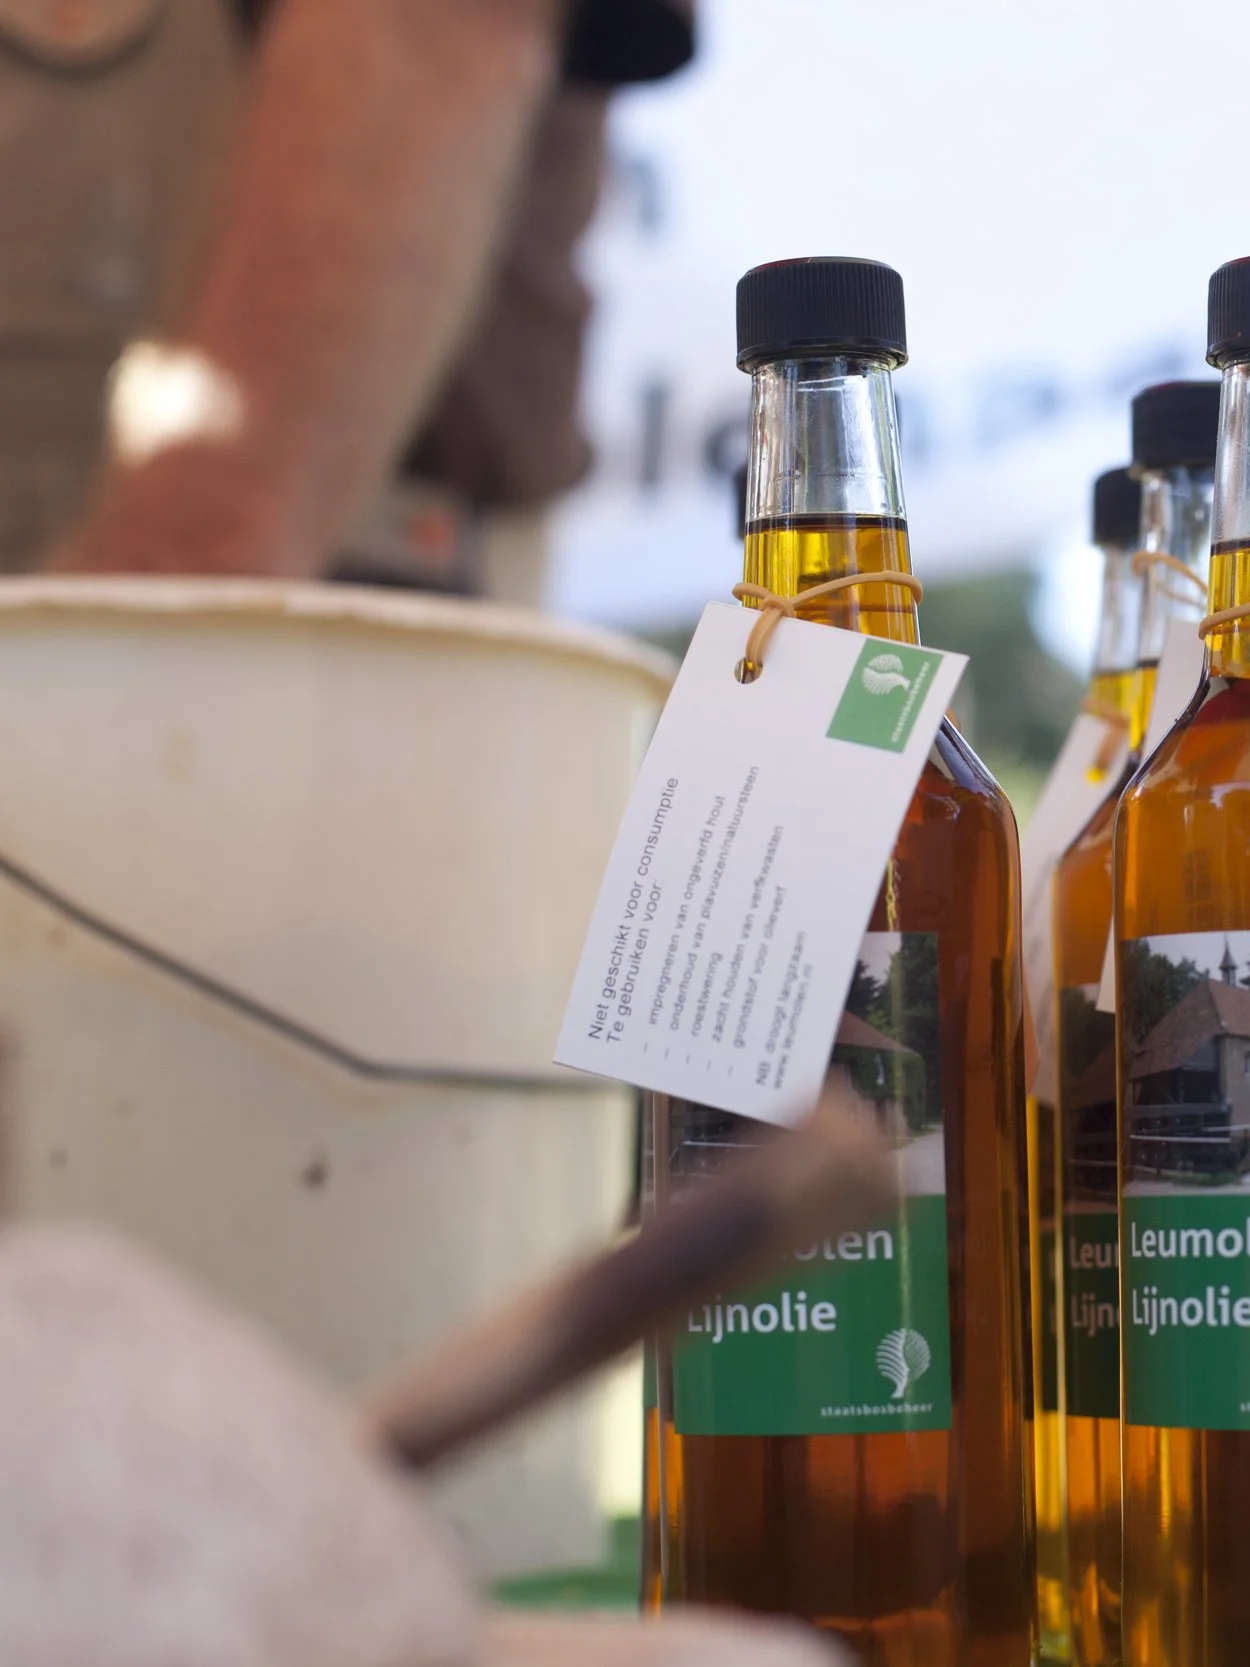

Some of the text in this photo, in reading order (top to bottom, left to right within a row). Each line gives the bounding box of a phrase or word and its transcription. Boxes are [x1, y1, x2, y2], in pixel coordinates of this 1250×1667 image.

[588, 777, 679, 1040] Niet geschikt voor consumptie
[649, 795, 726, 1025] impregneren van ongeverfd hout
[754, 943, 769, 975] voor
[606, 1020, 625, 1043] Te
[617, 928, 650, 1017] gebruiken
[670, 952, 698, 1031] onderhoud
[692, 922, 706, 949] van
[690, 951, 724, 1037] roestwering
[711, 1002, 731, 1042] zacht
[721, 944, 745, 999] houden
[741, 913, 756, 940] van
[820, 1403, 934, 1417] staatsbosbeheer
